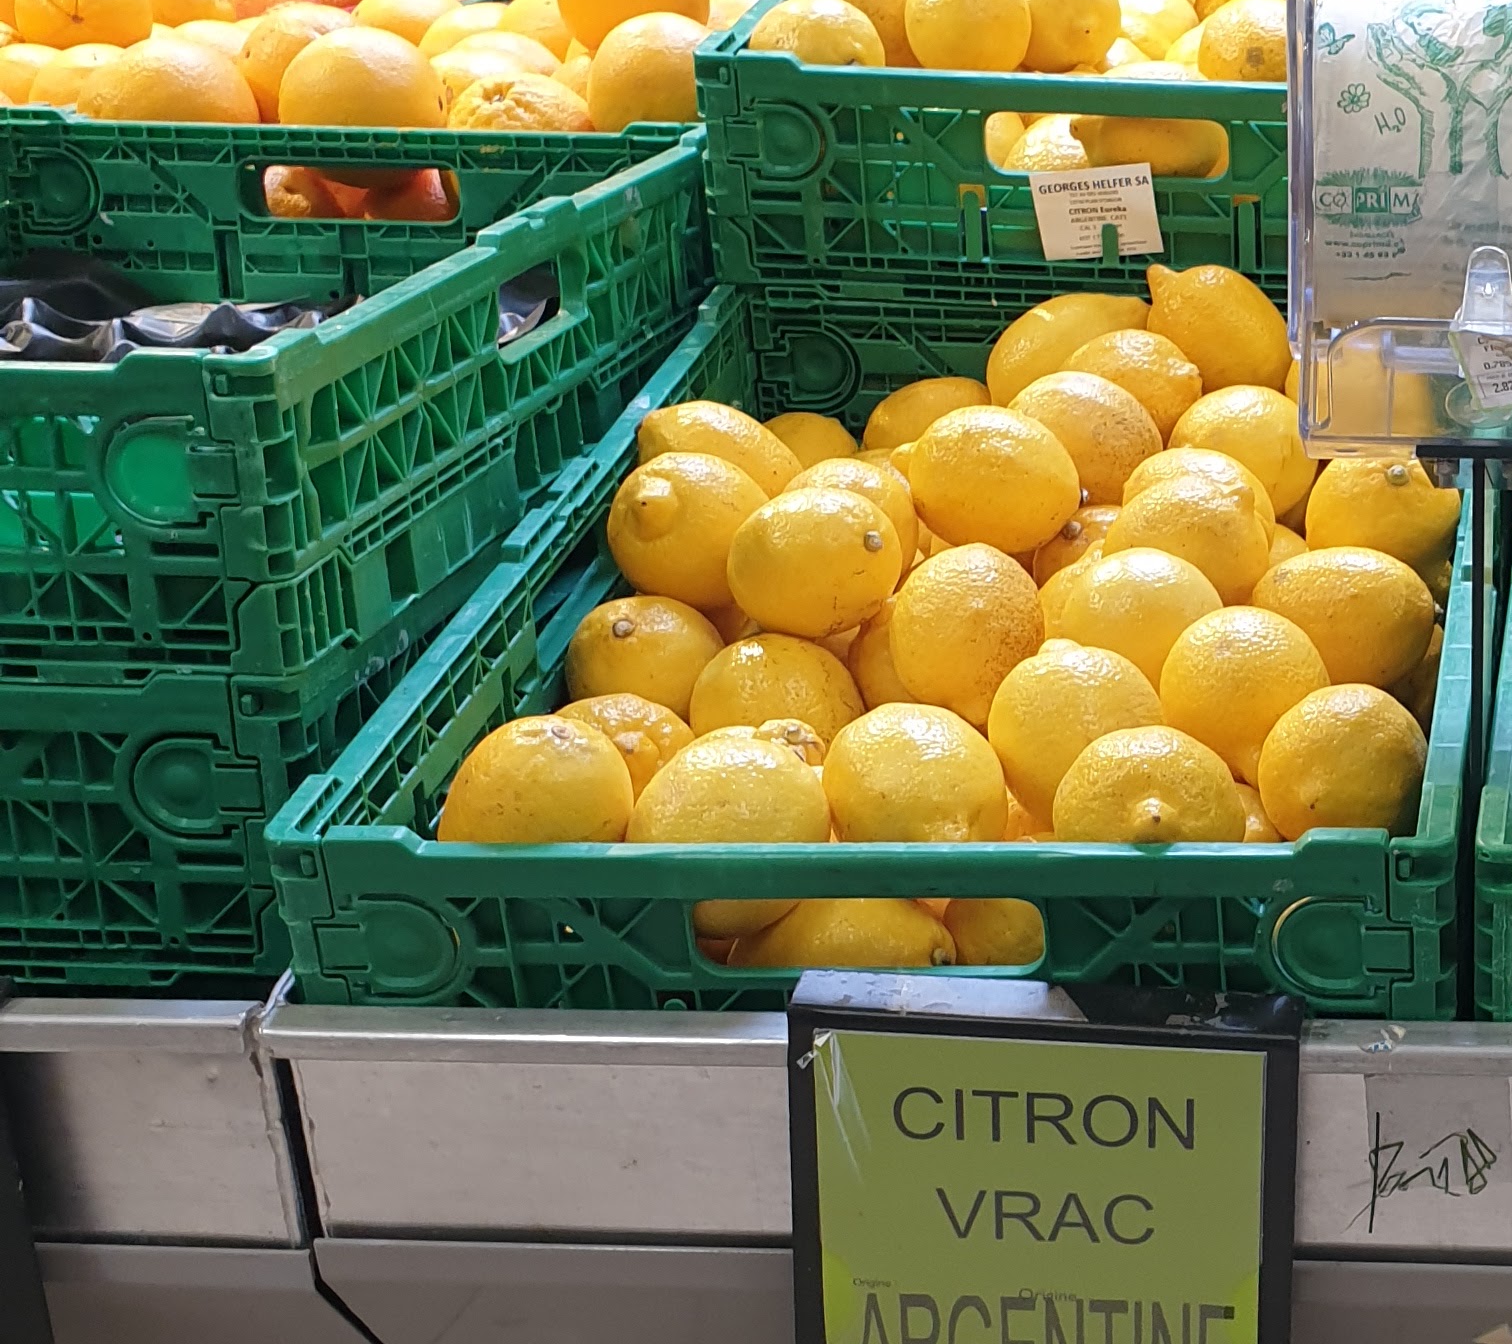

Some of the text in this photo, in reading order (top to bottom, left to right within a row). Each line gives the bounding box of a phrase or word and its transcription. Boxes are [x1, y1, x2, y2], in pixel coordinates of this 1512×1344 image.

[1039, 181, 1090, 195] GEORGES
[1092, 177, 1132, 190] HELFER
[1134, 175, 1150, 186] SA
[1068, 207, 1099, 216] CITRON
[893, 1087, 1195, 1150] CITRON
[935, 1187, 1155, 1245] VRAC
